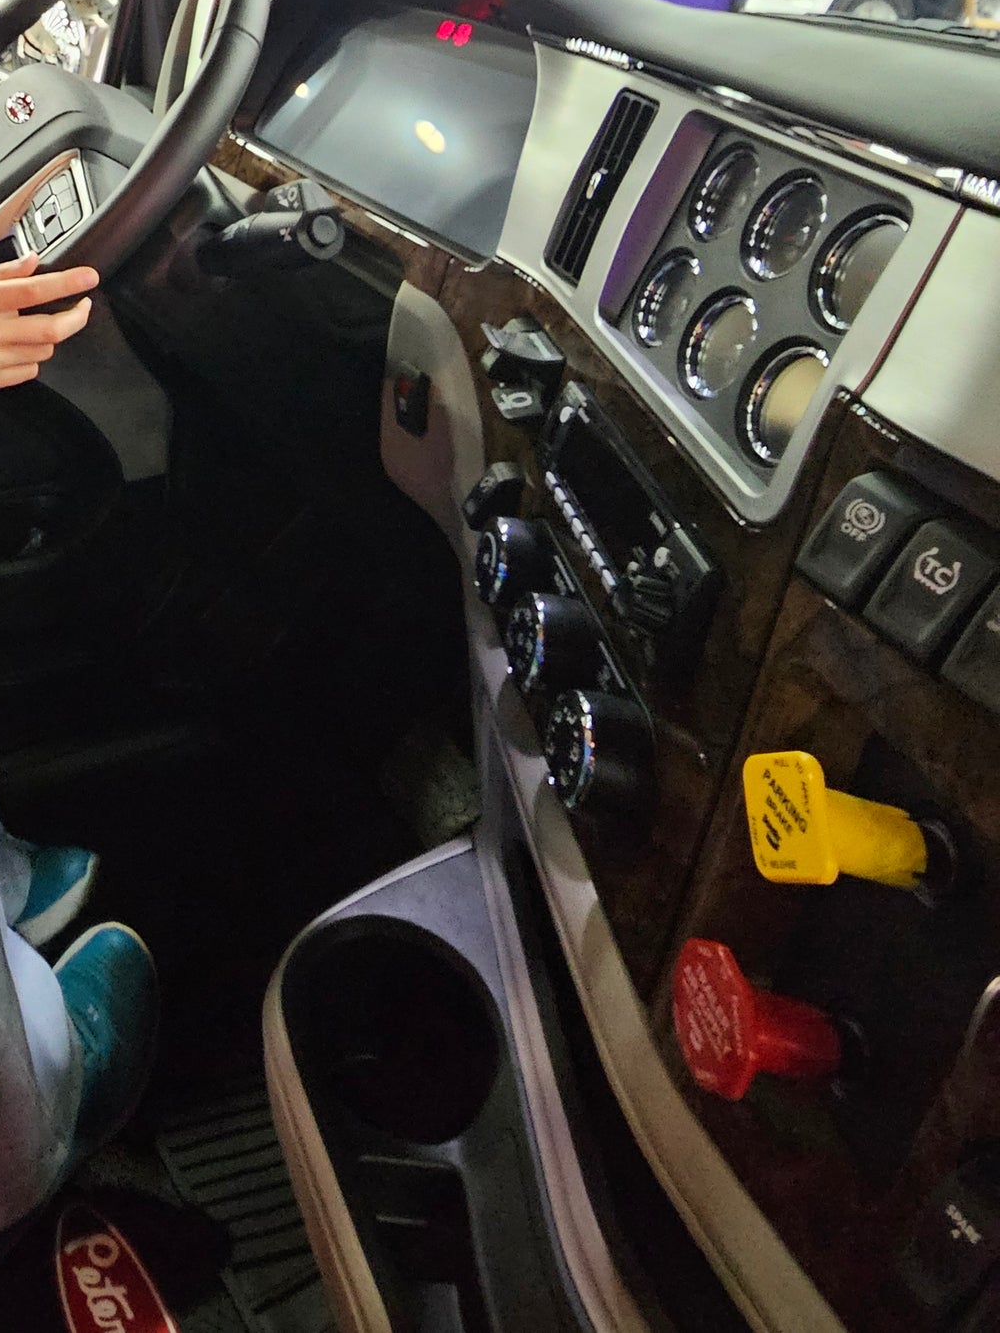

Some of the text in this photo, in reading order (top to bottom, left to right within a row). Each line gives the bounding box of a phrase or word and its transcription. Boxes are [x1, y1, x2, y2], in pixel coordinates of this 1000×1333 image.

[840, 522, 868, 542] OFF
[923, 556, 954, 587] TC
[763, 768, 808, 834] PARKING
[766, 795, 793, 836] BRAKE
